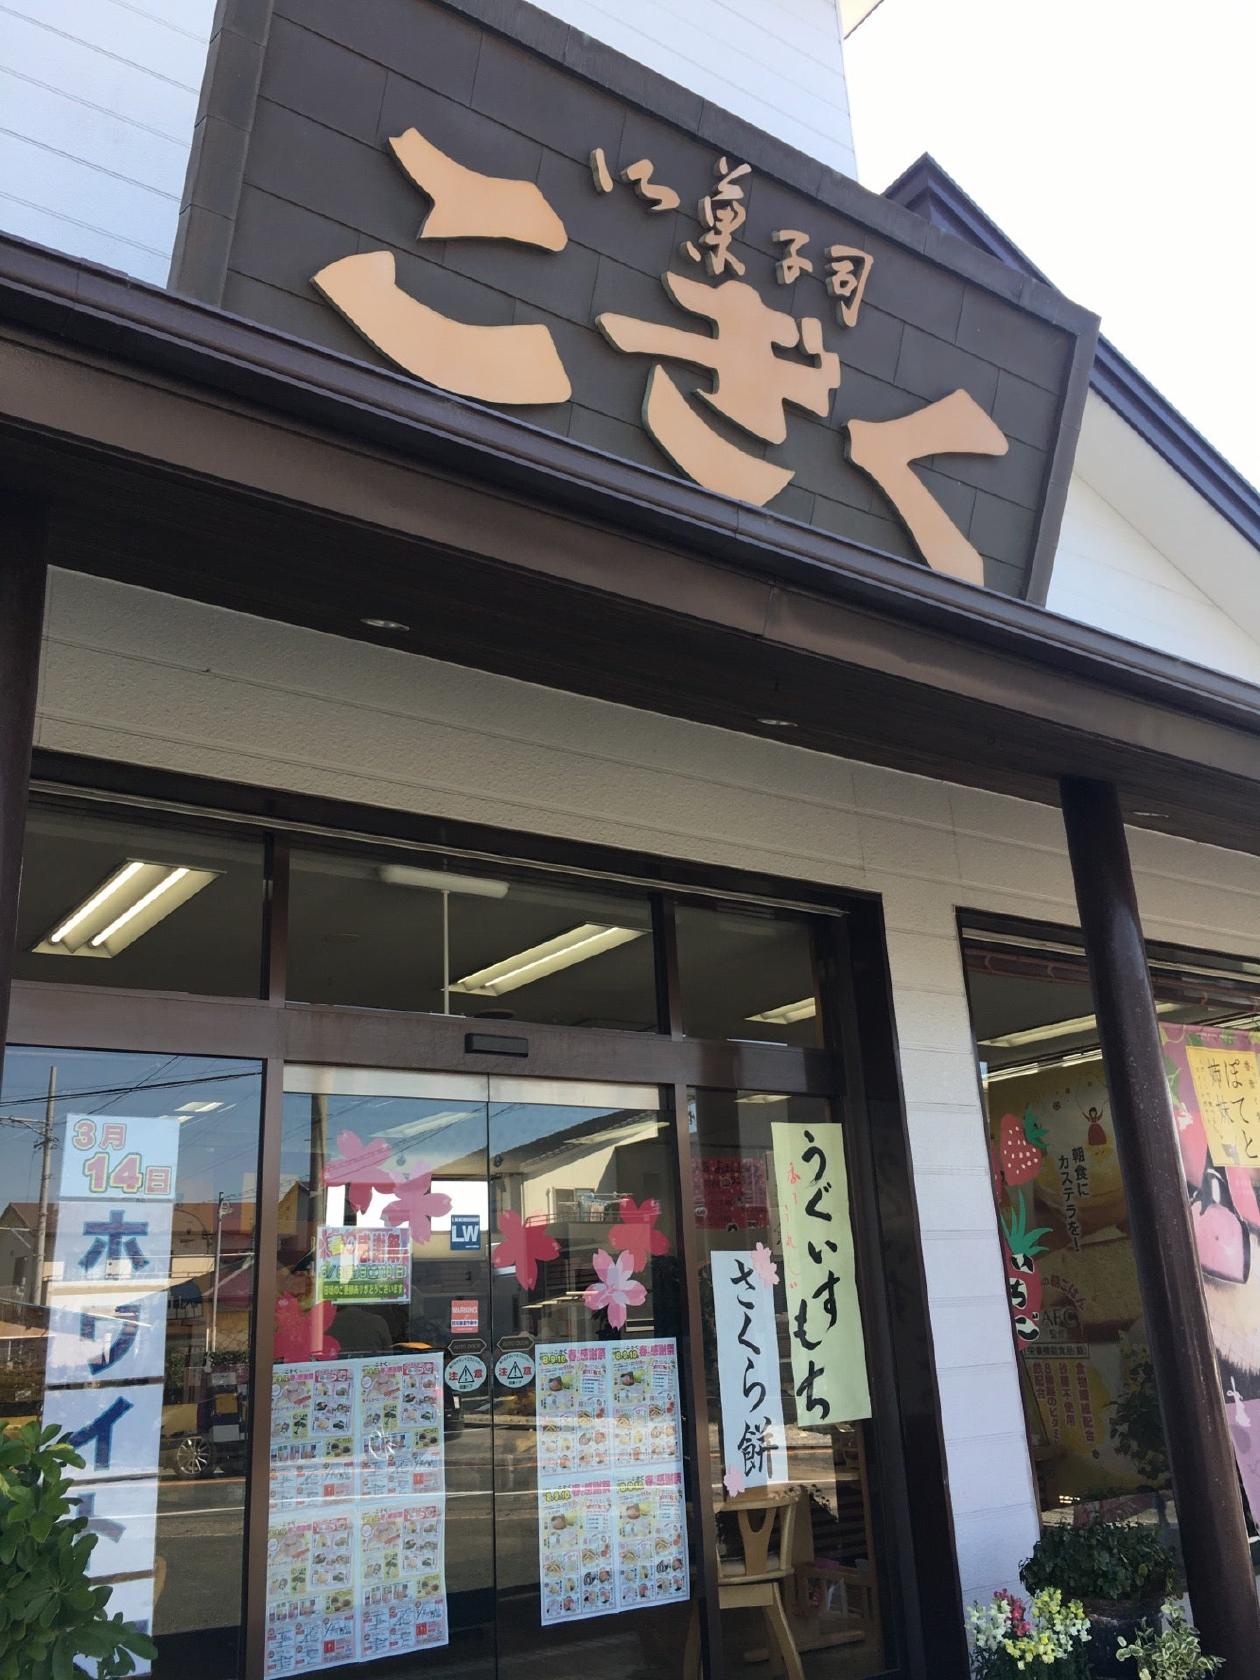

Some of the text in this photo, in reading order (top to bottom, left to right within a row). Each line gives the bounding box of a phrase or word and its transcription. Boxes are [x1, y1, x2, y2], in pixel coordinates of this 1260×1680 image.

[312, 127, 1010, 588] こぎく
[72, 1122, 126, 1150] 3月
[1224, 1058, 1259, 1159] ぽてと
[84, 1153, 172, 1195] 14日
[1072, 1147, 1090, 1197] 朝食に
[452, 1225, 480, 1242] LW
[730, 1258, 779, 1480] さくら餅
[69, 1209, 150, 1634] ホワイト
